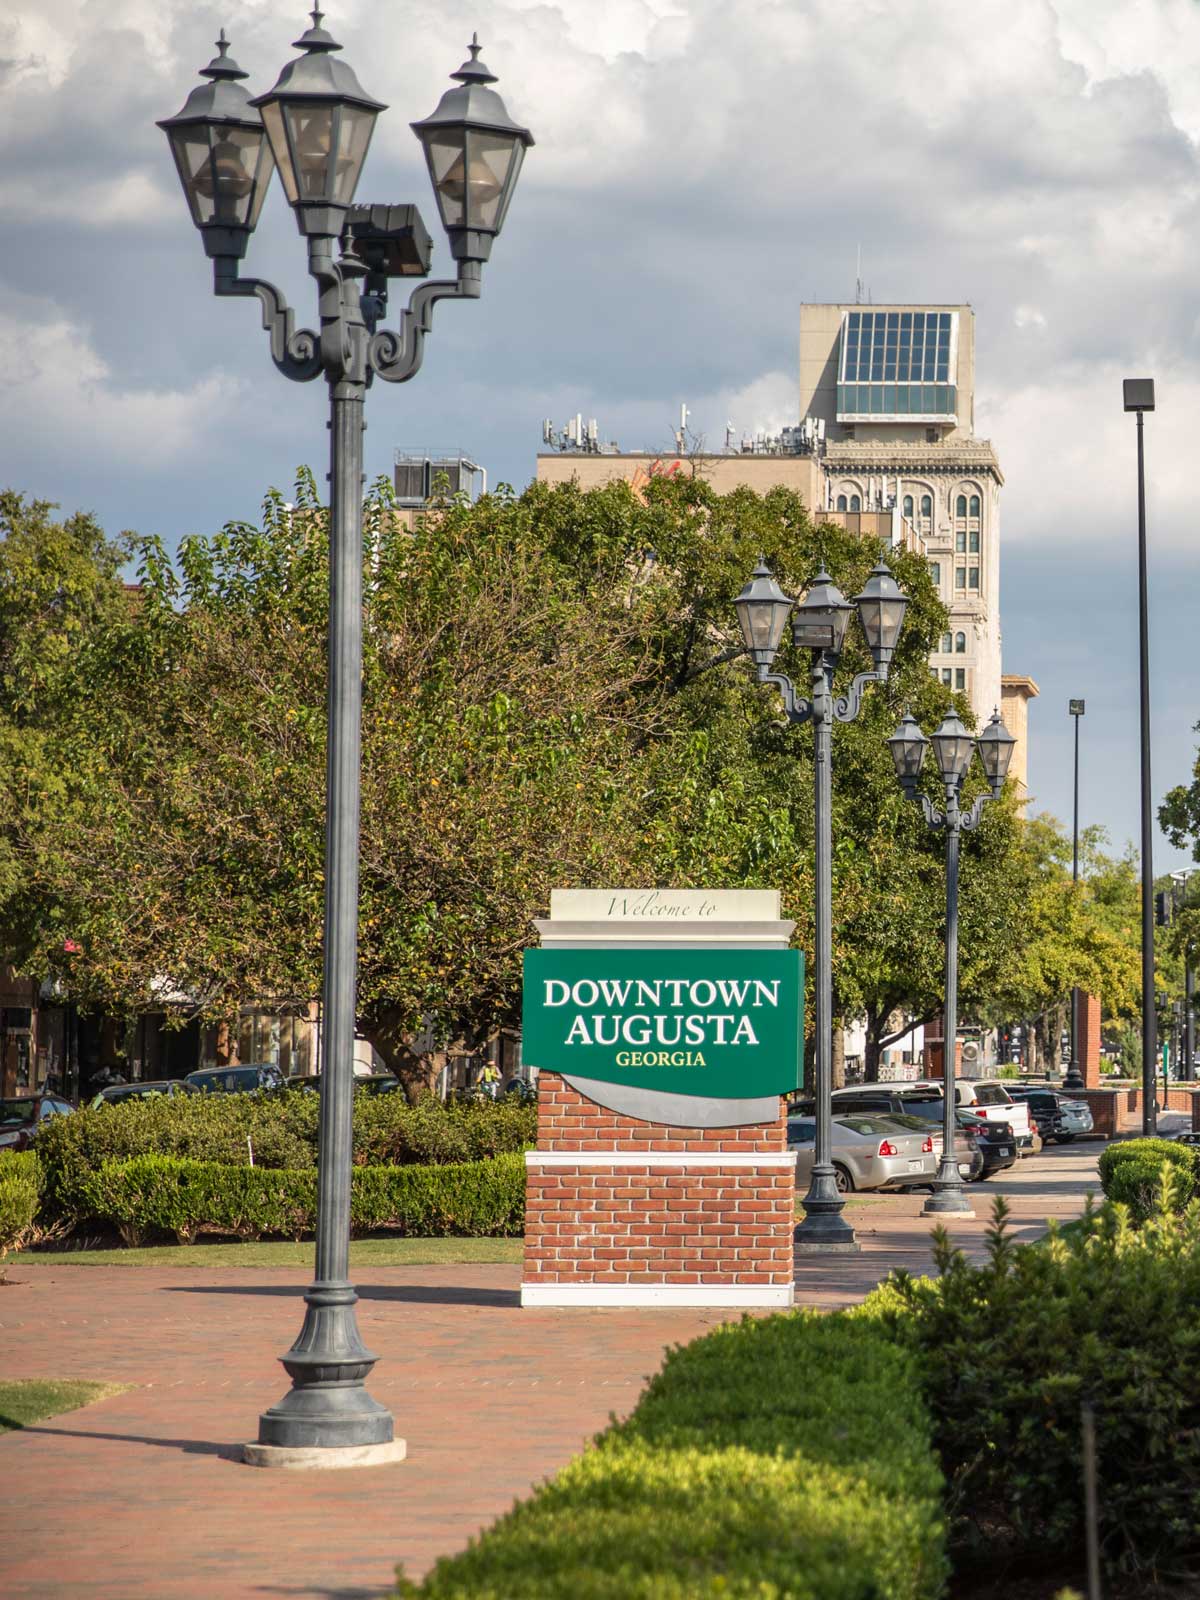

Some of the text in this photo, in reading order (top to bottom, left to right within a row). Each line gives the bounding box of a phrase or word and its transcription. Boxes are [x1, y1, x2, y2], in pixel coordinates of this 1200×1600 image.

[607, 891, 718, 916] Welcome to
[543, 979, 781, 1007] DOWNTOWN
[564, 1014, 759, 1045] AUGUSTA
[615, 1051, 706, 1066] GEORGIA
